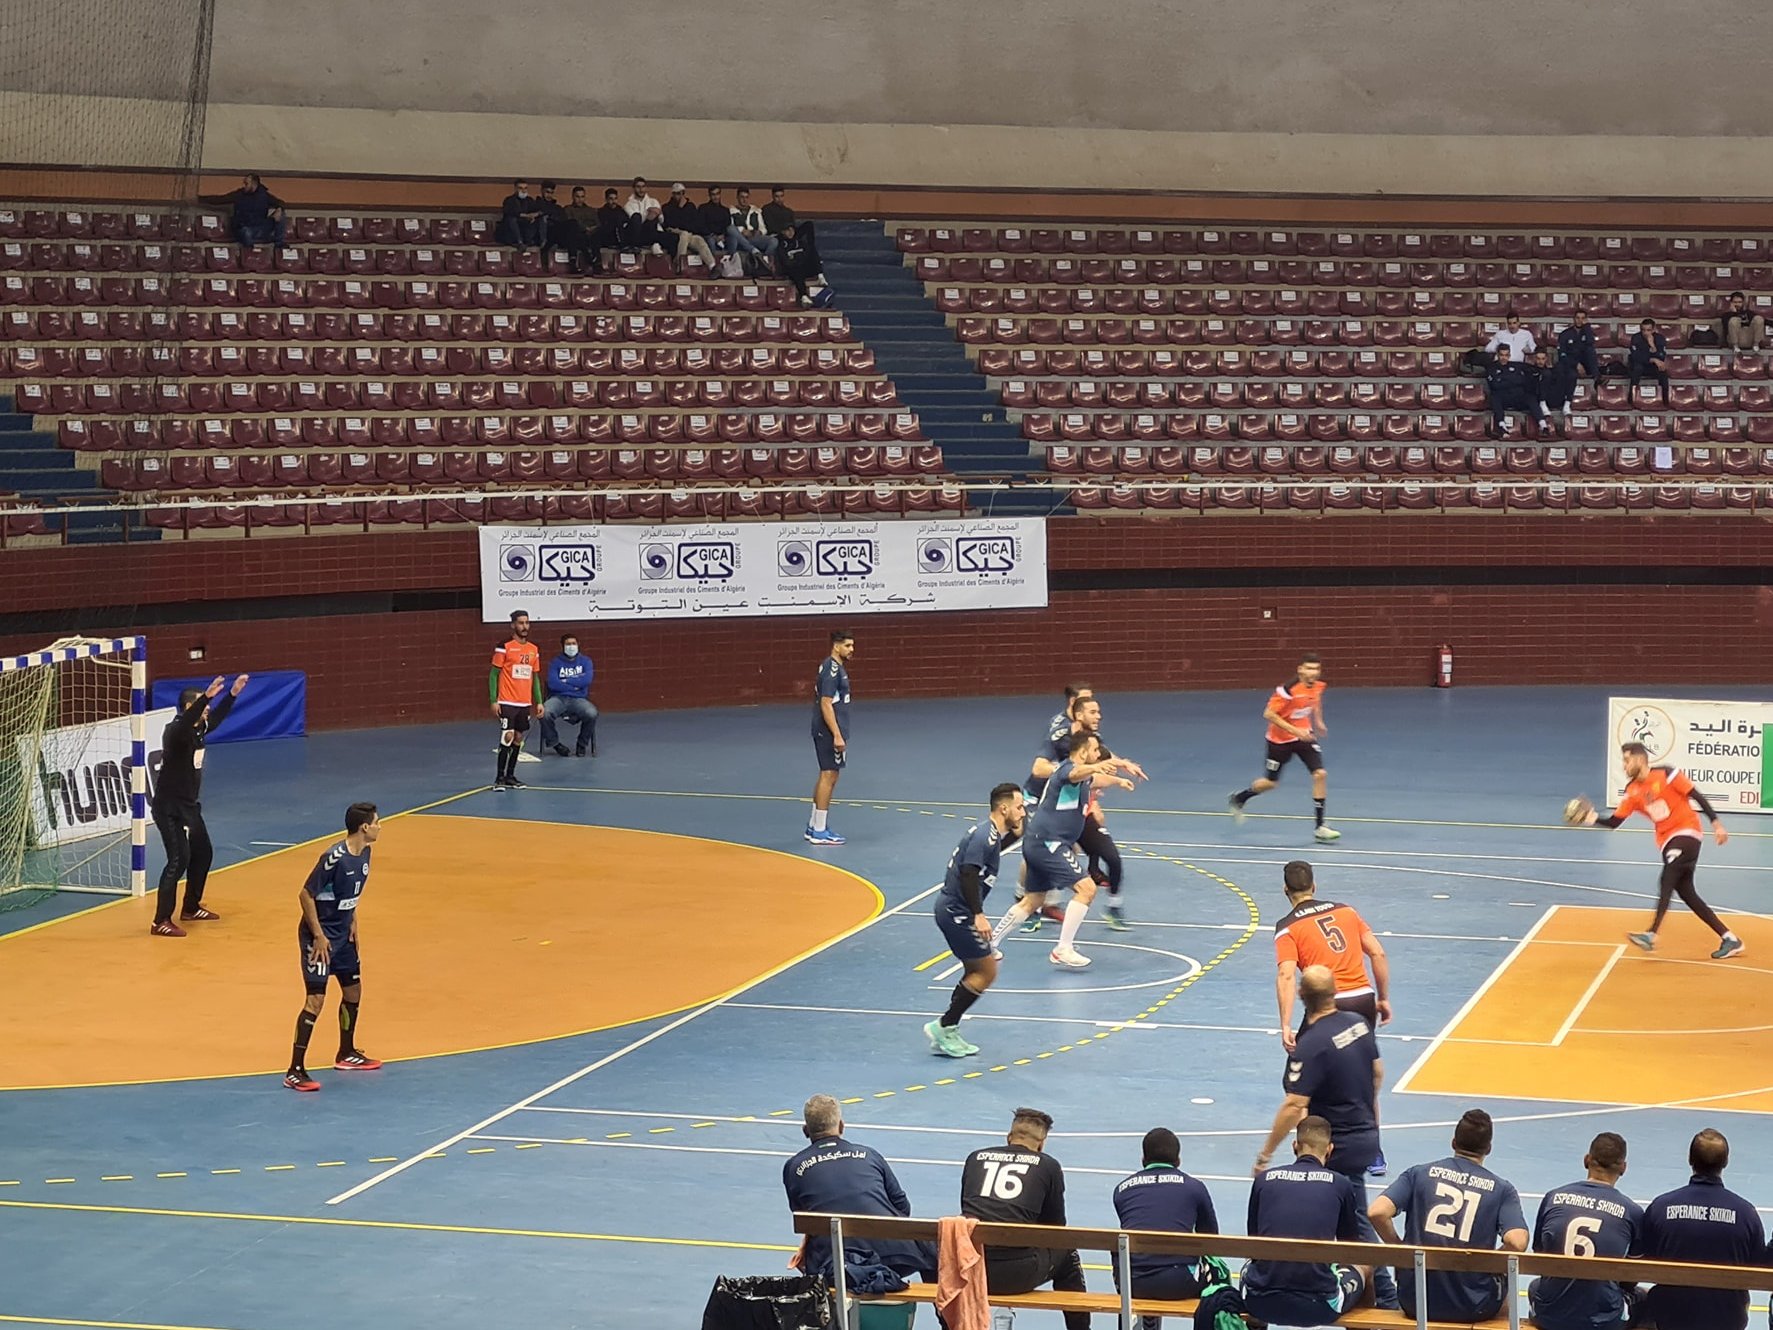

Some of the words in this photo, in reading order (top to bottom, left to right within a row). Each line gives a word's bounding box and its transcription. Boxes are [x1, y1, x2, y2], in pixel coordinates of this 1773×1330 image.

[699, 548, 728, 561] GICA
[838, 546, 867, 559] GICA
[978, 542, 1009, 555] GICA
[560, 551, 590, 563] GICA
[638, 587, 658, 595] Groupe
[659, 586, 685, 594] Industriel
[686, 585, 696, 593] des
[697, 585, 720, 593] Ciments
[799, 583, 825, 591] Industriel
[826, 582, 836, 590] des
[837, 582, 859, 590] Ciments
[917, 580, 938, 588] Groupe
[966, 579, 976, 587] des
[498, 589, 519, 598] Groupe
[520, 588, 545, 596] Industriel
[546, 588, 556, 596] des
[558, 588, 580, 596] Ciments
[1689, 719, 1732, 737] اليد
[1688, 741, 1760, 757] FÉDÉRATIO
[1716, 769, 1755, 784] COUPE
[1739, 791, 1760, 804] EDI
[1315, 914, 1348, 954] 5
[976, 1152, 1015, 1162] ESPERANCE
[1015, 1154, 1041, 1165] SKIKDA
[980, 1161, 1030, 1200] 16
[1265, 1169, 1308, 1181] ESPERANCE
[1307, 1171, 1334, 1183] SKIKDA
[1428, 1166, 1470, 1185] ESPERANCE
[1468, 1175, 1495, 1191] SKIKDA
[1118, 1175, 1158, 1193] ESPERANCE
[1158, 1174, 1184, 1184] SKIKDA
[1424, 1182, 1482, 1242] 21
[1553, 1193, 1596, 1209] ESPERANCE
[1596, 1200, 1625, 1218] SKIKDA
[1666, 1204, 1709, 1220] ESPERANCE
[1709, 1207, 1736, 1224] SKIKDA
[1564, 1216, 1603, 1257] 6
